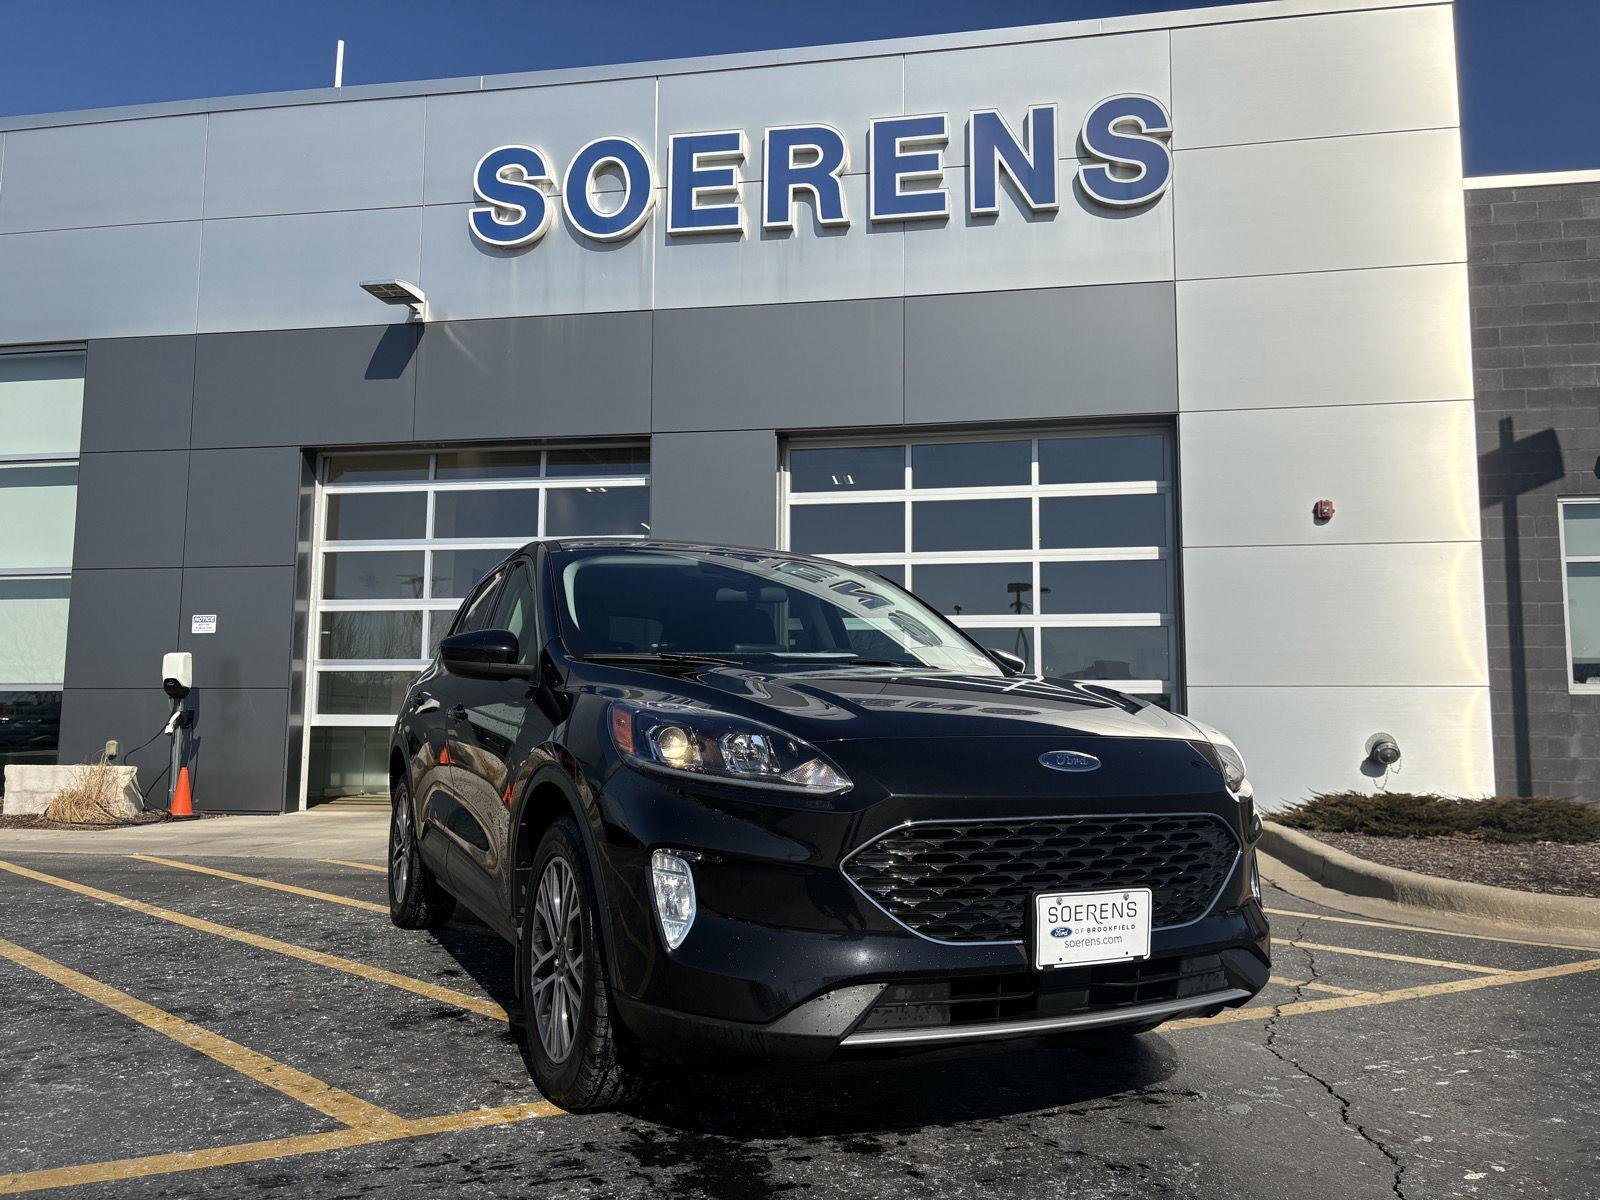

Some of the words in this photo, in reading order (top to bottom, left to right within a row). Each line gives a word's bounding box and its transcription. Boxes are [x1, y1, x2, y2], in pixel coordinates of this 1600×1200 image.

[469, 93, 1173, 248] SOERENS
[1048, 901, 1137, 924] SOERENS
[1087, 925, 1136, 934] BROOKFIELD
[1065, 936, 1122, 949] soerens.com
